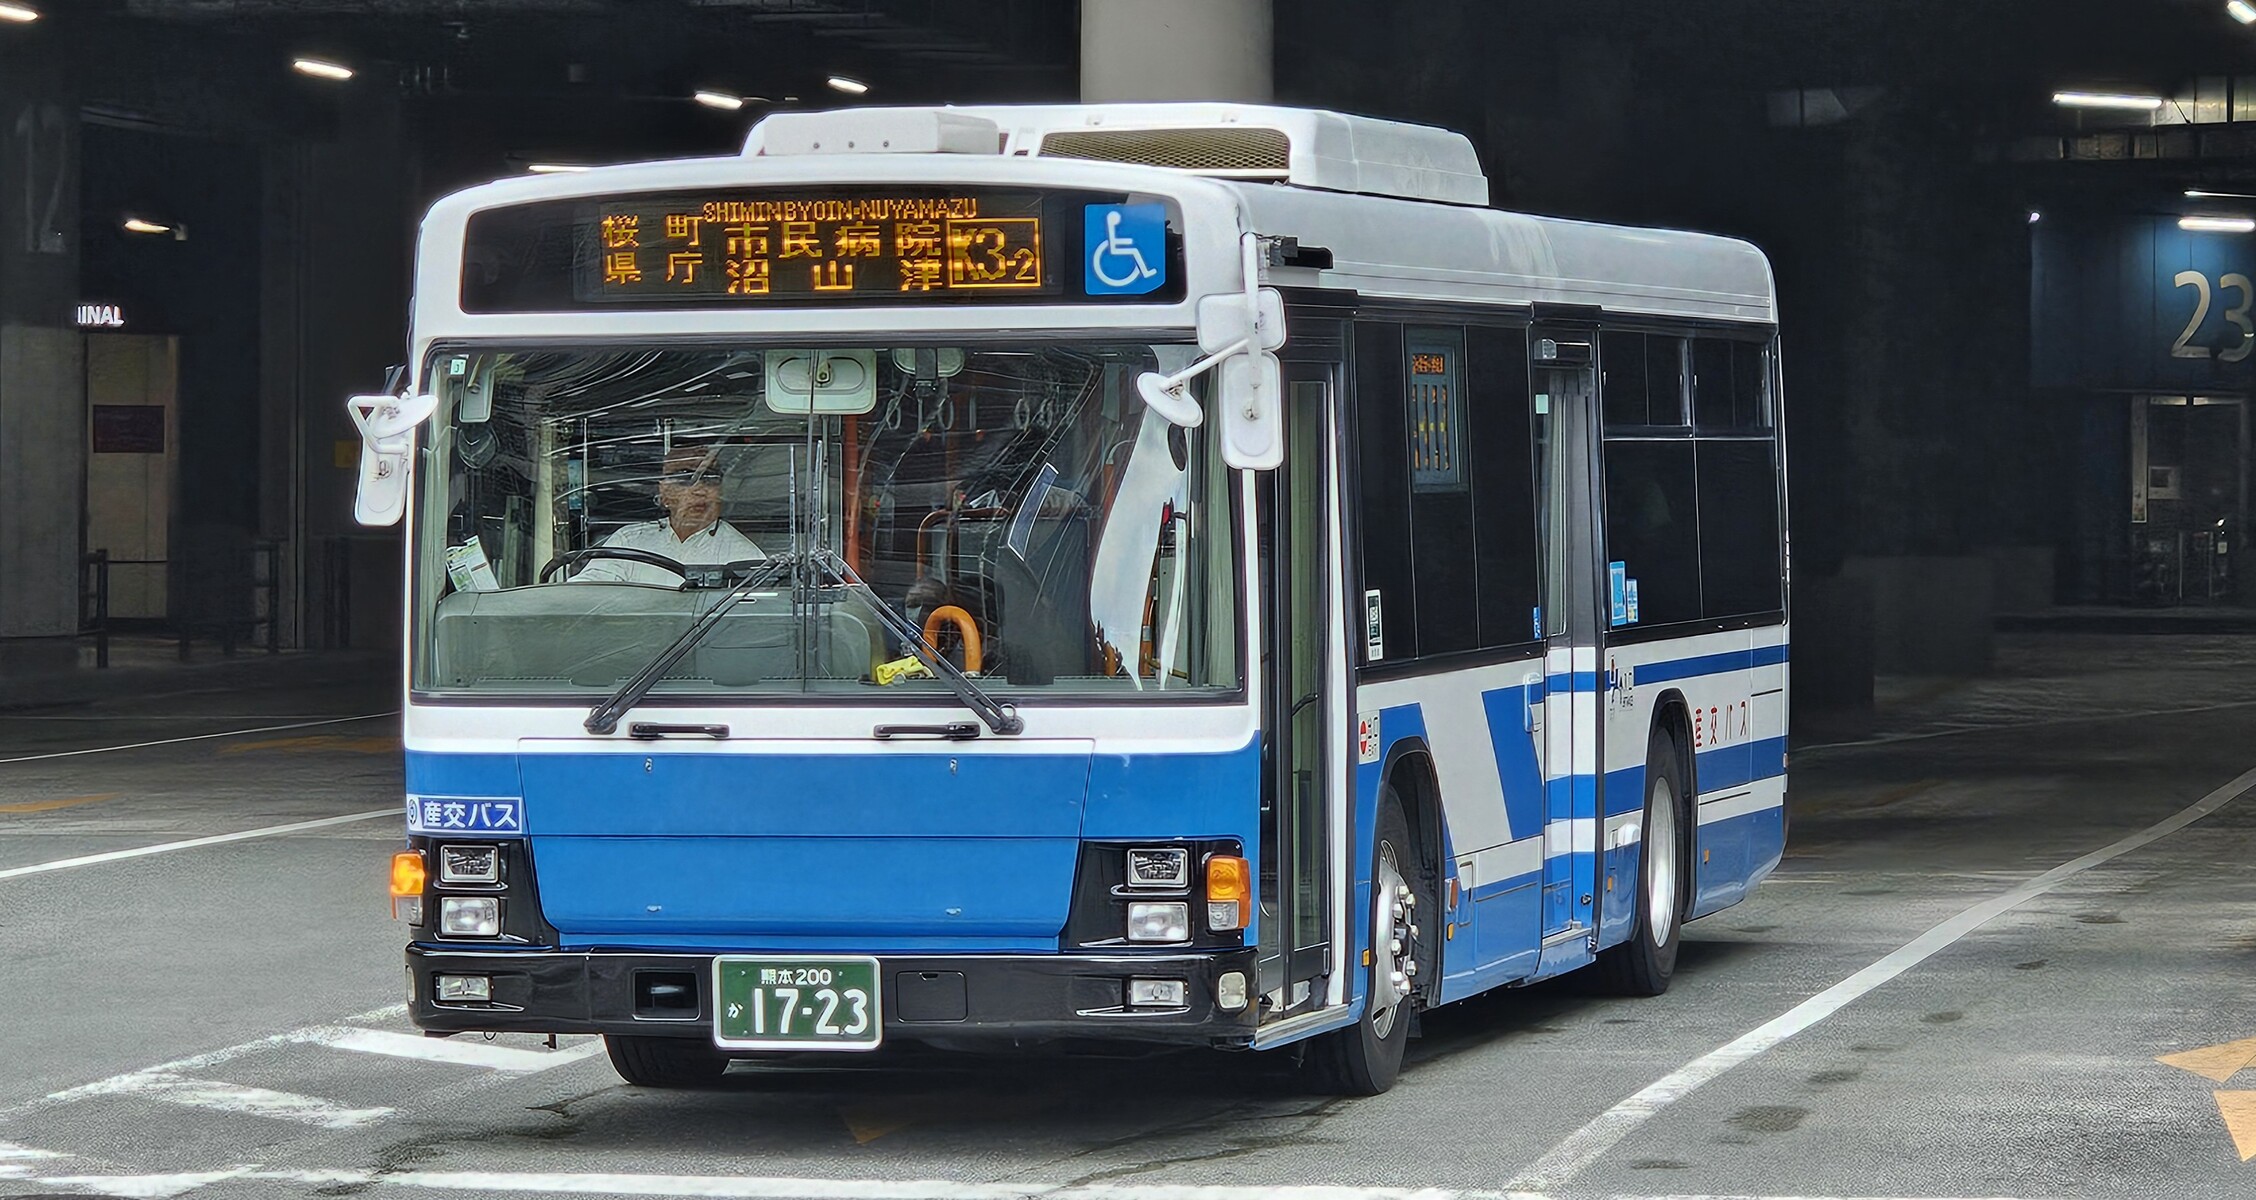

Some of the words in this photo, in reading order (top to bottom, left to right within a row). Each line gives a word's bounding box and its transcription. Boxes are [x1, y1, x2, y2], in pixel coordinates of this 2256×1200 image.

[724, 221, 942, 258] 市民病院
[951, 227, 1036, 281] K3-2
[725, 257, 943, 294] 沼山津
[77, 305, 125, 325] INAL
[2171, 271, 2255, 362] 23
[423, 800, 518, 829] 産交バス
[727, 1002, 743, 1019] か
[754, 988, 868, 1035] 17-23
